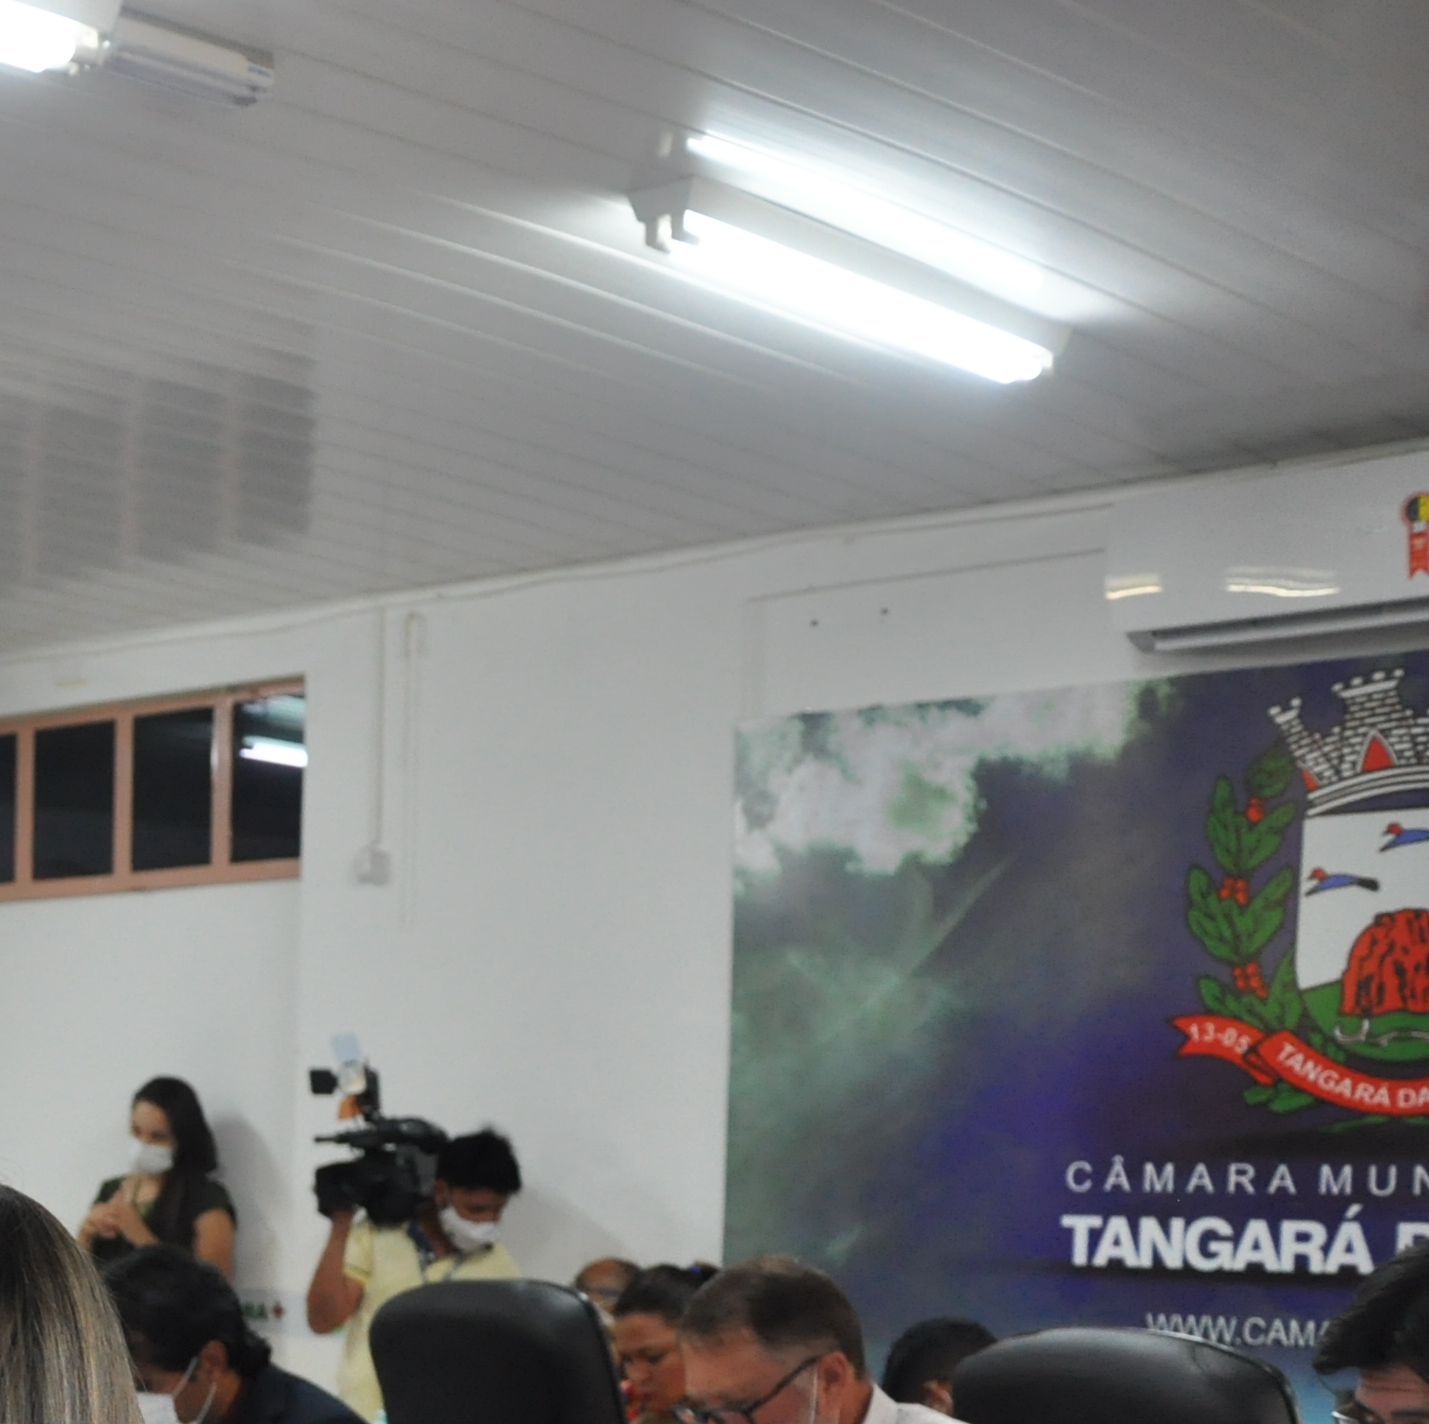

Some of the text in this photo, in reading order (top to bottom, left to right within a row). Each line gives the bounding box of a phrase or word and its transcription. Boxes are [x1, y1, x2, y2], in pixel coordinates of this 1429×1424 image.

[1189, 1021, 1252, 1055] 13-05
[1275, 1041, 1391, 1107] TANGARÁ
[1065, 1154, 1297, 1195] CÂMARA
[1060, 1203, 1376, 1275] TANGARÁ
